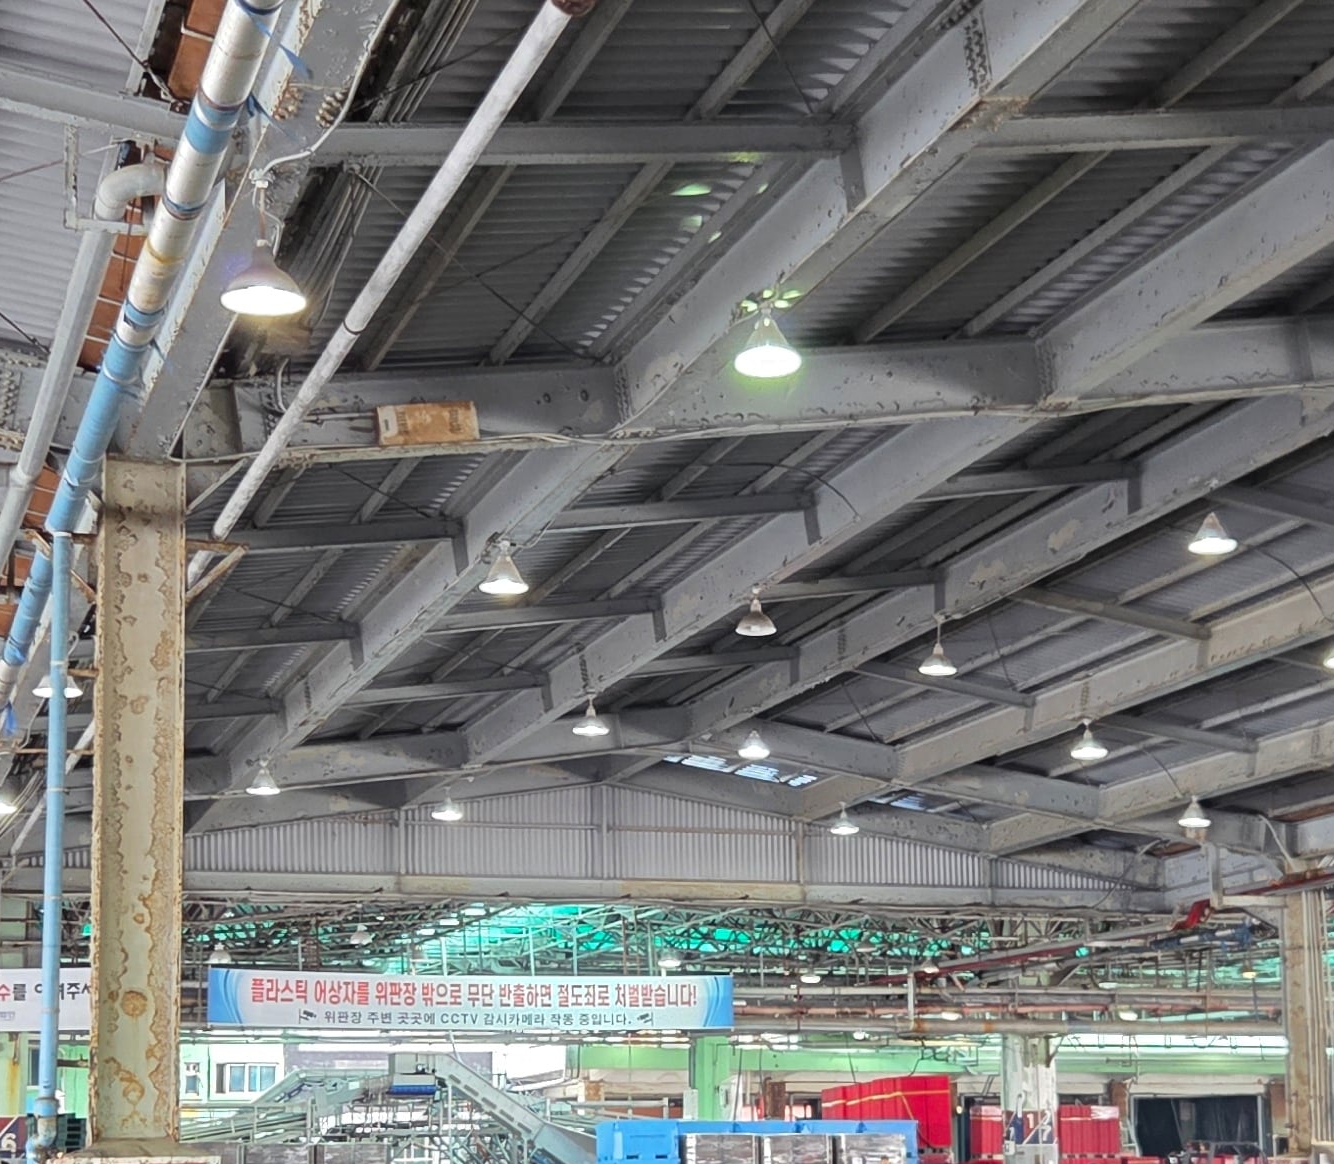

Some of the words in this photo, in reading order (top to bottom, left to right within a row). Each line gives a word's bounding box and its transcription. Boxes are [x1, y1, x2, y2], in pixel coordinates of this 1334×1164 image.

[250, 977, 307, 1004] 플라스틱
[314, 979, 370, 1006] 어상자를
[375, 980, 417, 1007] 위판장
[421, 981, 463, 1008] 밖으로
[467, 982, 495, 1008] 무단
[498, 982, 553, 1009] 반출하면
[557, 982, 611, 1009] 절도죄로
[614, 982, 697, 1009] 처벌받습니다!
[323, 1010, 363, 1025] 위판장
[367, 1011, 393, 1025] 주변
[397, 1011, 436, 1026] 곳곳에
[440, 1013, 478, 1025] CCTV
[483, 1012, 545, 1027] 감시카메라
[549, 1012, 574, 1027] 작동
[578, 1012, 632, 1027] 중입니다.
[1, 1132, 17, 1153] 6
